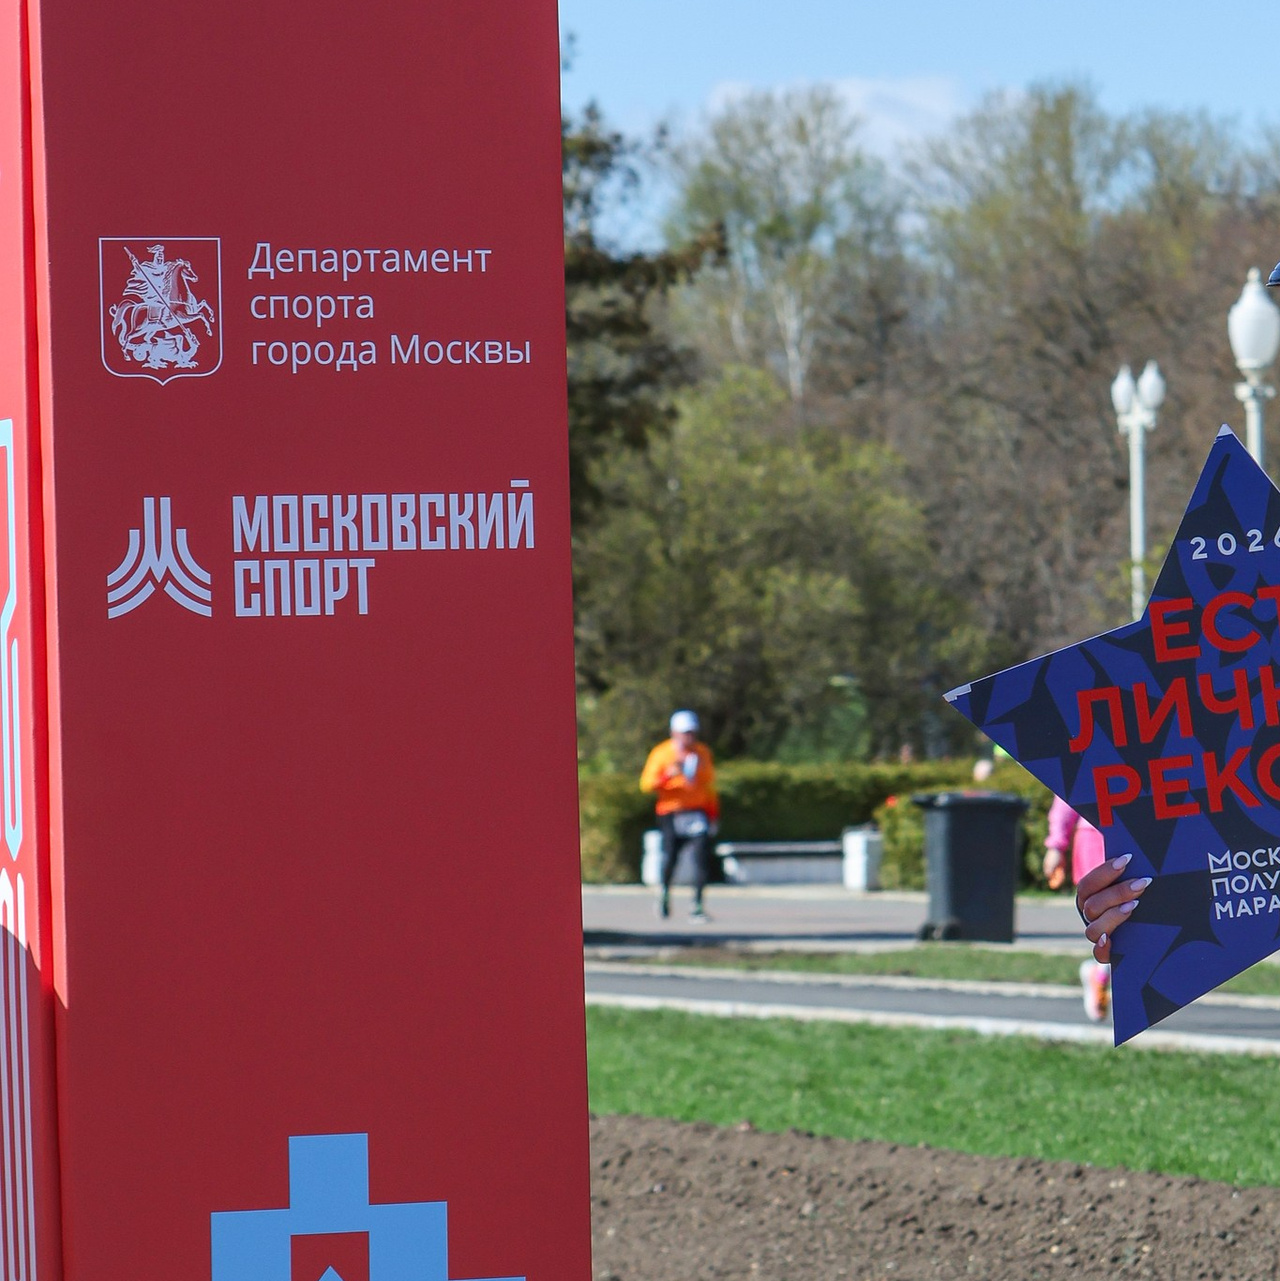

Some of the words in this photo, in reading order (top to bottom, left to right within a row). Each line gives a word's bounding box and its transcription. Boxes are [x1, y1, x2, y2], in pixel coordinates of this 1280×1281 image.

[248, 242, 491, 282] Департамент
[250, 295, 374, 327] спорта
[252, 341, 377, 373] города
[390, 334, 531, 364] Москвы
[233, 480, 535, 552] МОСКОВСКИЙ
[234, 558, 375, 617] СПОРТ
[1211, 870, 1280, 897] ПОЛУ
